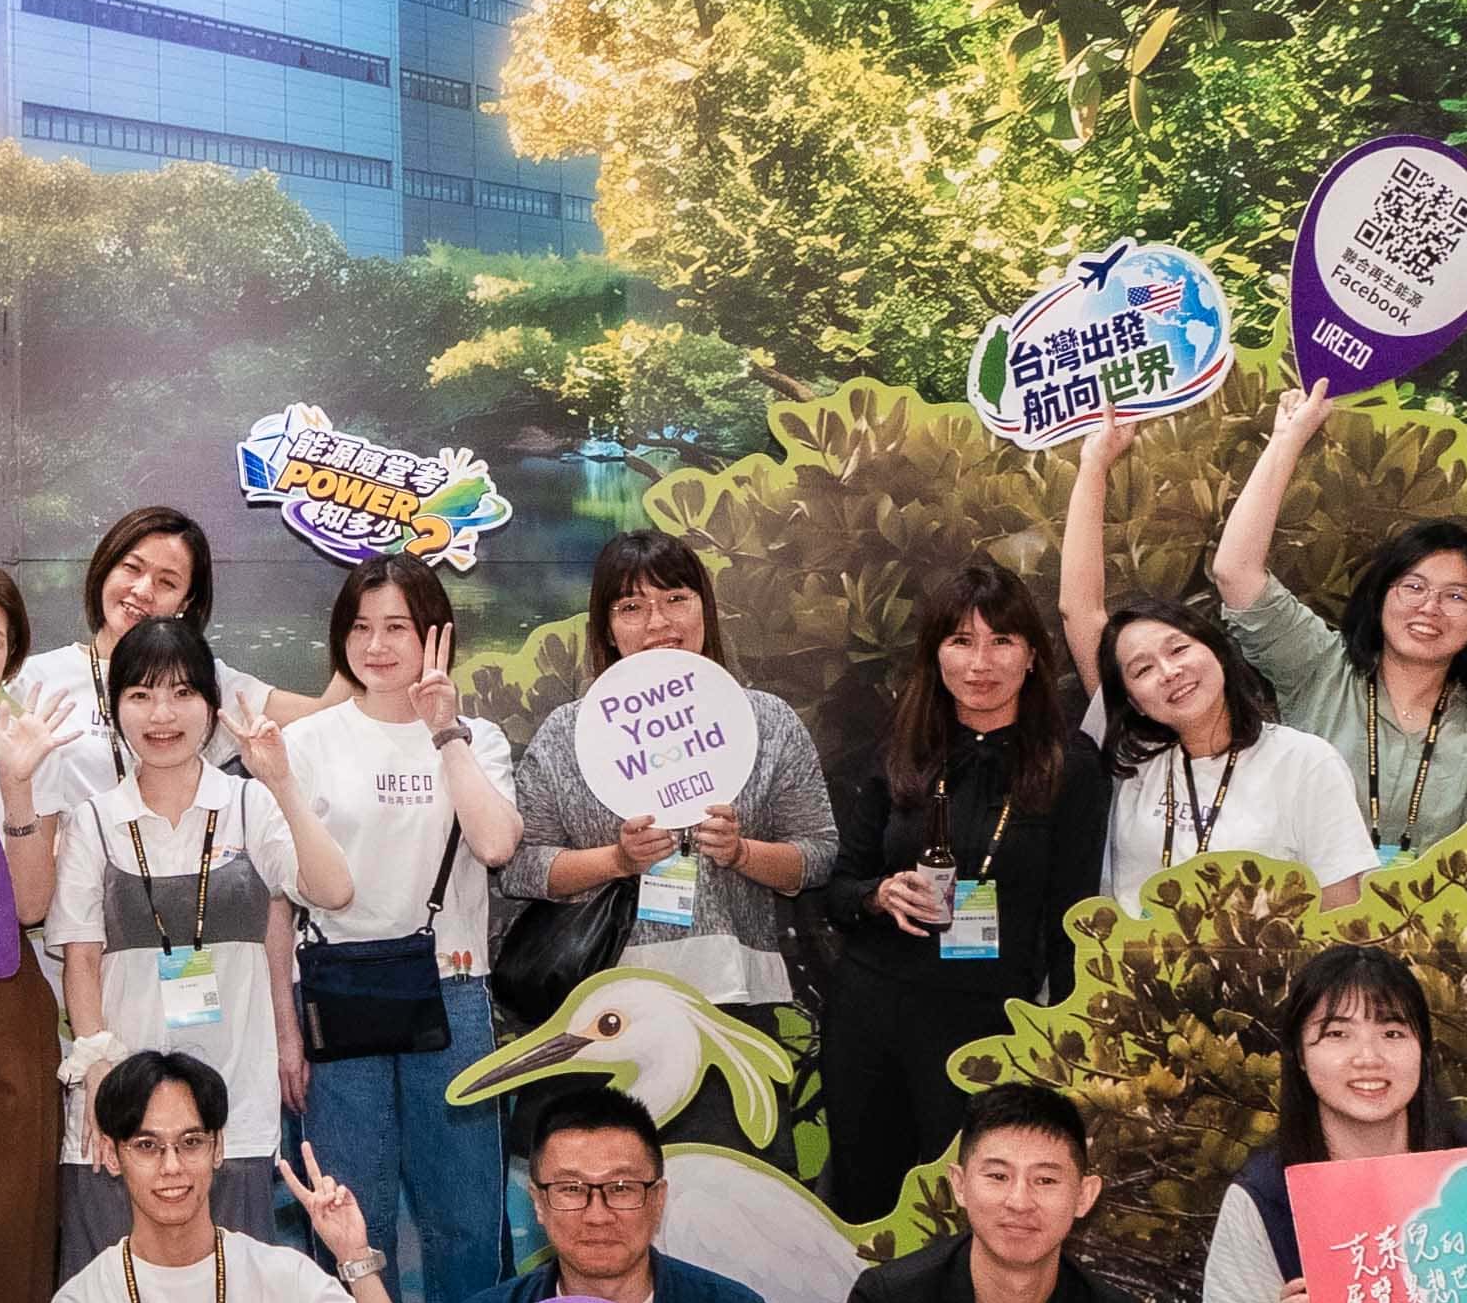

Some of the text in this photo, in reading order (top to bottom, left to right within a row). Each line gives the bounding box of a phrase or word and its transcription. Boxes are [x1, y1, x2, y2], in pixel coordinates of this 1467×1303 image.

[1331, 264, 1412, 327] Facebook
[1341, 247, 1424, 308] 聯合再生能源
[1009, 310, 1148, 387] 台灣出發
[1311, 317, 1374, 371] URECO
[1022, 344, 1175, 434] 航向世界
[275, 459, 420, 523] POWER
[288, 430, 448, 492] 能源隨堂考
[599, 671, 696, 723] Power
[621, 705, 695, 745] Your
[376, 774, 433, 792] URECO
[657, 770, 714, 809] URECO
